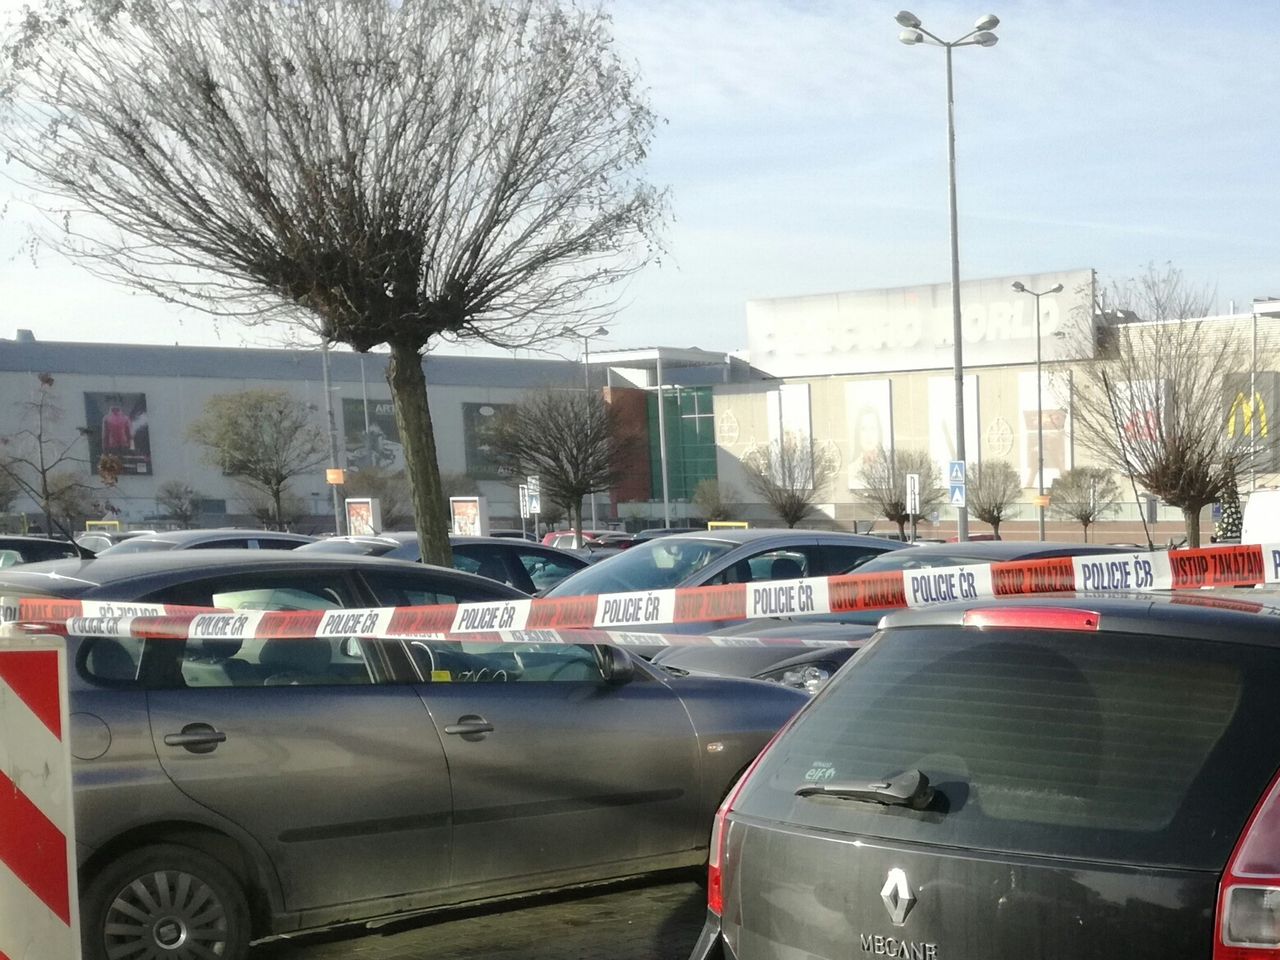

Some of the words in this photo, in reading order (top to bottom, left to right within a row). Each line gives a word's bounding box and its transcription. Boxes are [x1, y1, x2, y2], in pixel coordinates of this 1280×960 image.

[194, 616, 231, 636] POLICIE
[231, 613, 249, 636] ČR
[322, 613, 361, 635] POLICIE
[361, 610, 380, 633] ČR
[457, 606, 500, 630] POLICIE
[499, 600, 516, 629] ČR
[601, 597, 643, 624] POLICIE
[644, 592, 661, 622] ČR
[753, 585, 795, 614] POLICIE
[798, 580, 815, 612] ČR
[911, 572, 958, 603] POLICIE
[958, 567, 978, 599] ČR
[1081, 560, 1131, 591] POLICIE
[1133, 555, 1154, 588] ČR
[1170, 556, 1209, 585] VSTUP
